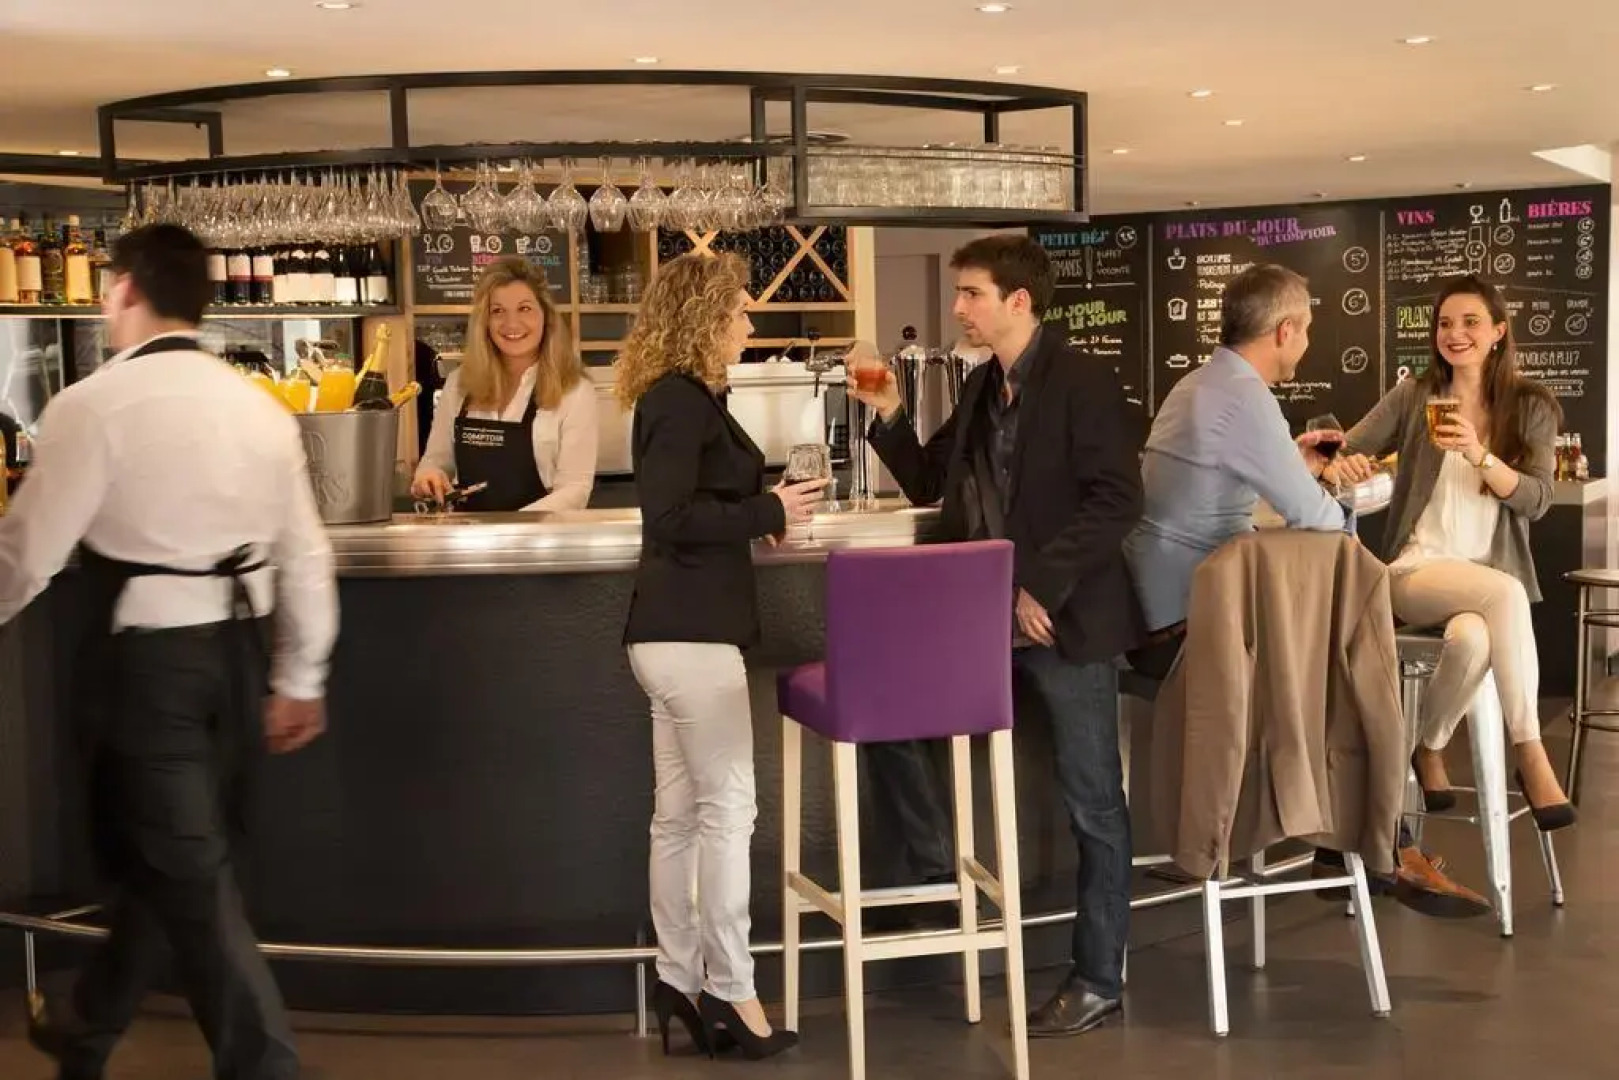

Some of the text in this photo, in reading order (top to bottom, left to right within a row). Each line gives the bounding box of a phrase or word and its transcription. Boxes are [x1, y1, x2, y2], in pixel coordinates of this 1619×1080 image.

[1397, 210, 1435, 225] VINS
[1528, 199, 1592, 218] BIÈRES
[1165, 217, 1299, 240] PLATS DU JOUR
[1257, 225, 1337, 246] DU COMPTOIR
[1039, 233, 1078, 246] PETIT
[1043, 300, 1106, 322] AU JOUR
[1087, 309, 1127, 327] JOUR
[461, 431, 505, 442] COMPTOIR
